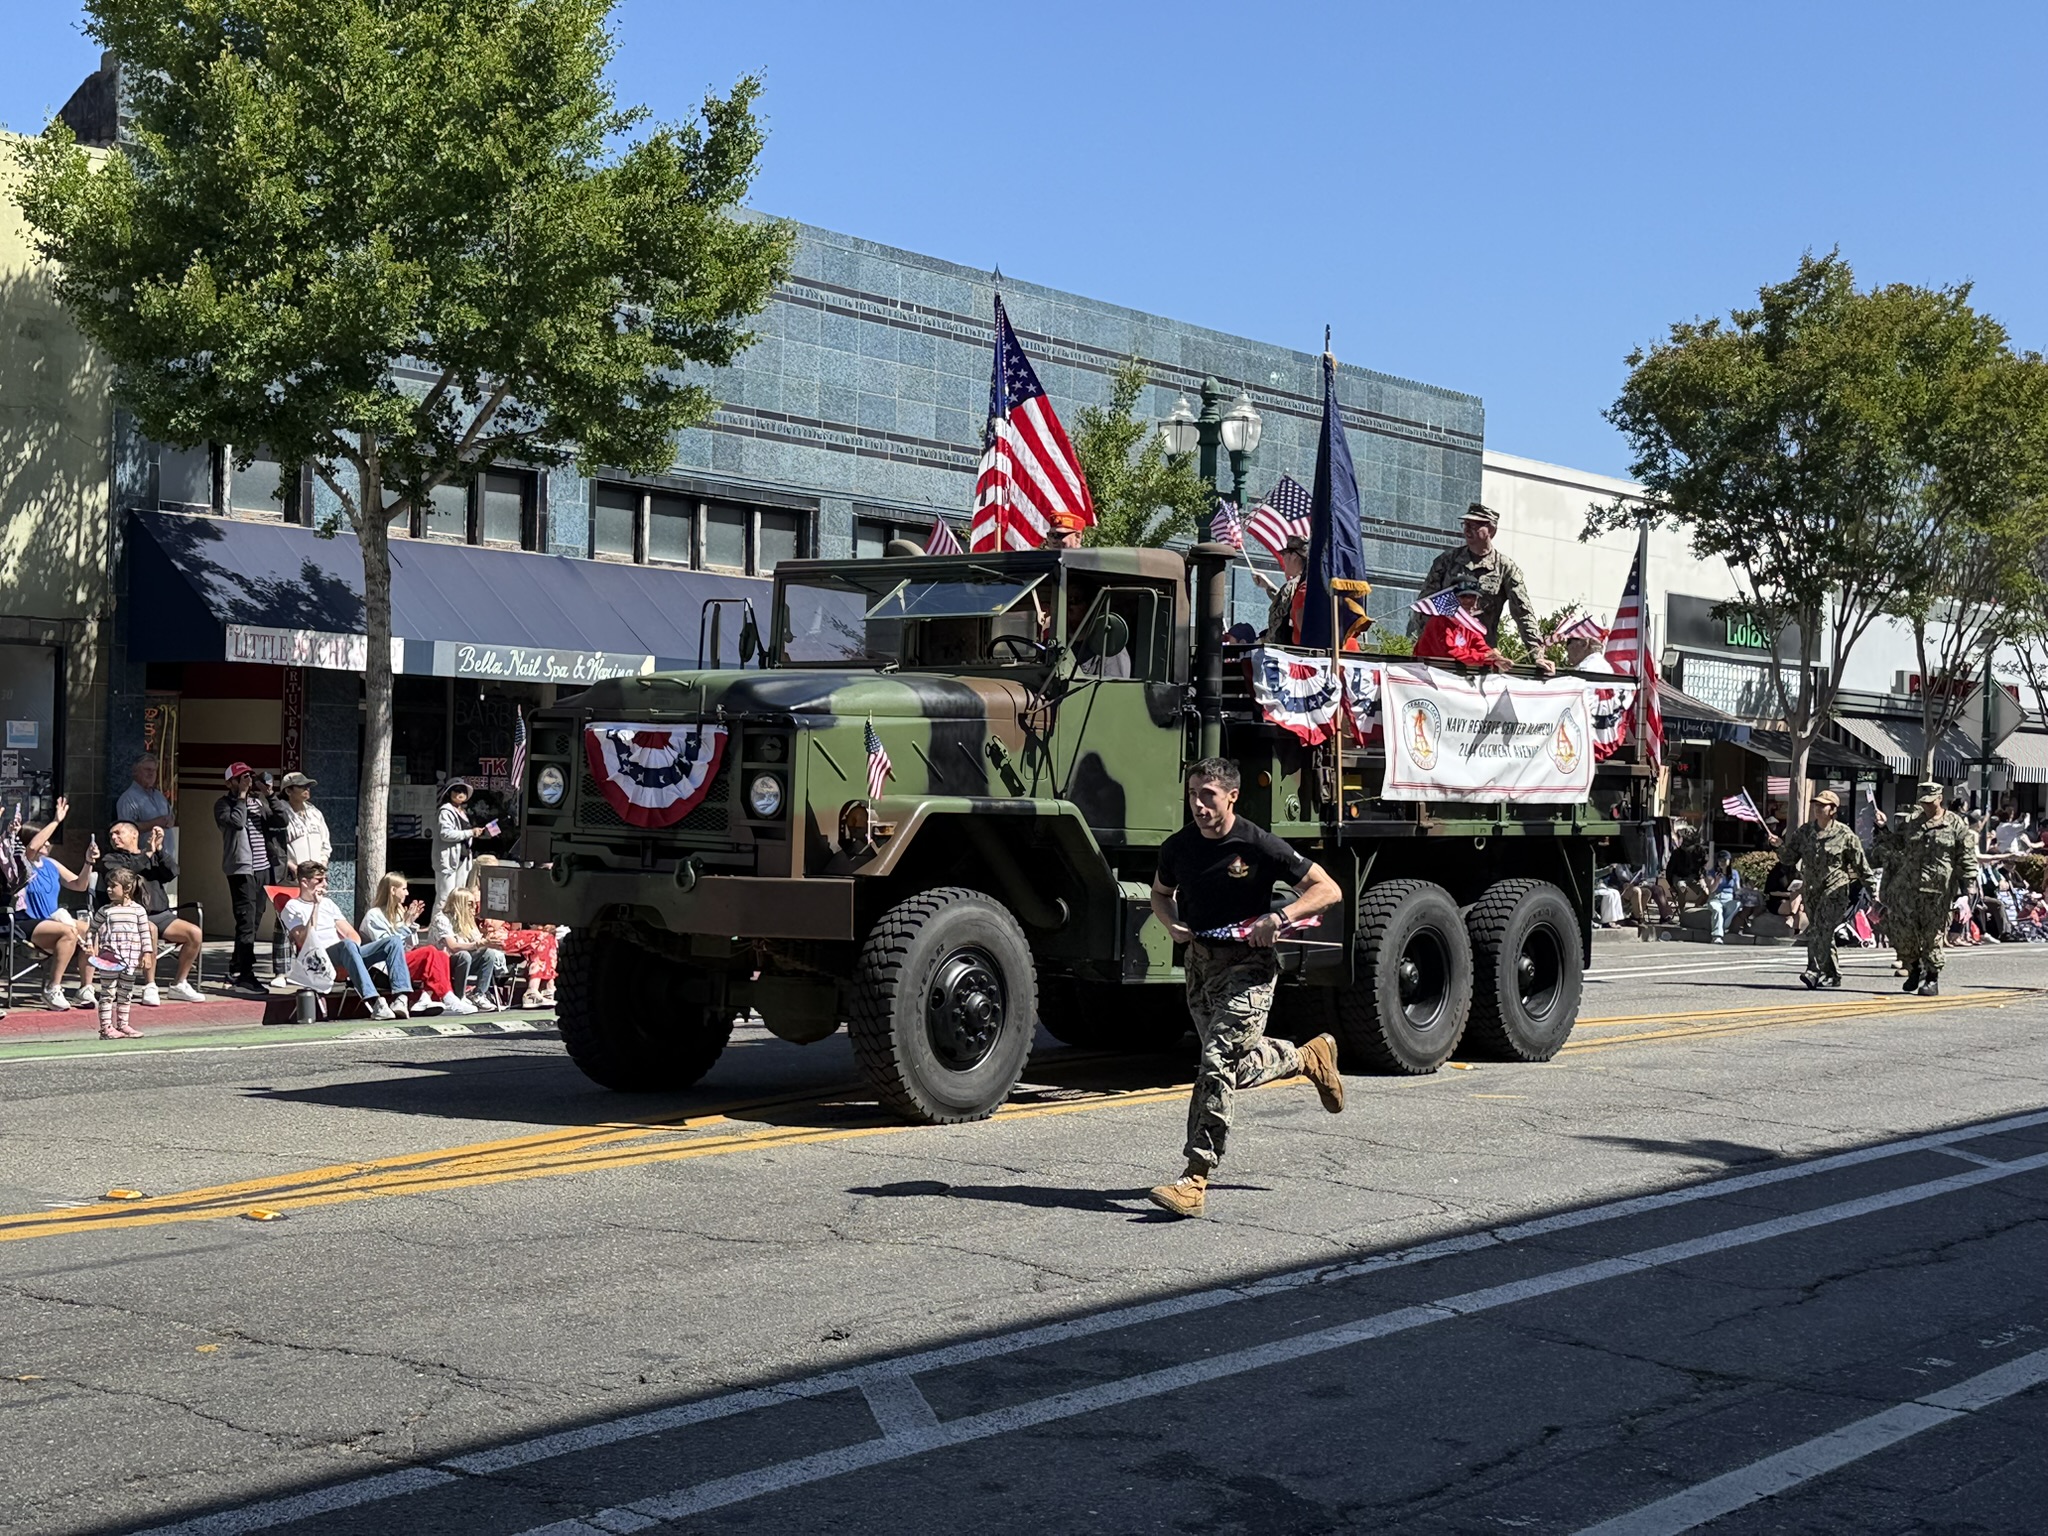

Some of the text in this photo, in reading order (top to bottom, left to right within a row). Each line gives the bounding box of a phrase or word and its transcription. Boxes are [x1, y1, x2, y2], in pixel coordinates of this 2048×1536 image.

[234, 632, 288, 661] LITTLE
[458, 645, 504, 675] Bella
[504, 649, 542, 677] Nail
[543, 655, 569, 682] Spa
[573, 655, 586, 680] &
[288, 667, 299, 727] RTUNE
[455, 699, 514, 727] BARB
[1445, 717, 1467, 733] NAVY
[1468, 719, 1501, 735] RESERVE
[1501, 720, 1526, 735] CENTER
[467, 729, 511, 756] SHO
[1479, 744, 1513, 758] CLEMENT
[478, 757, 508, 775] TK
